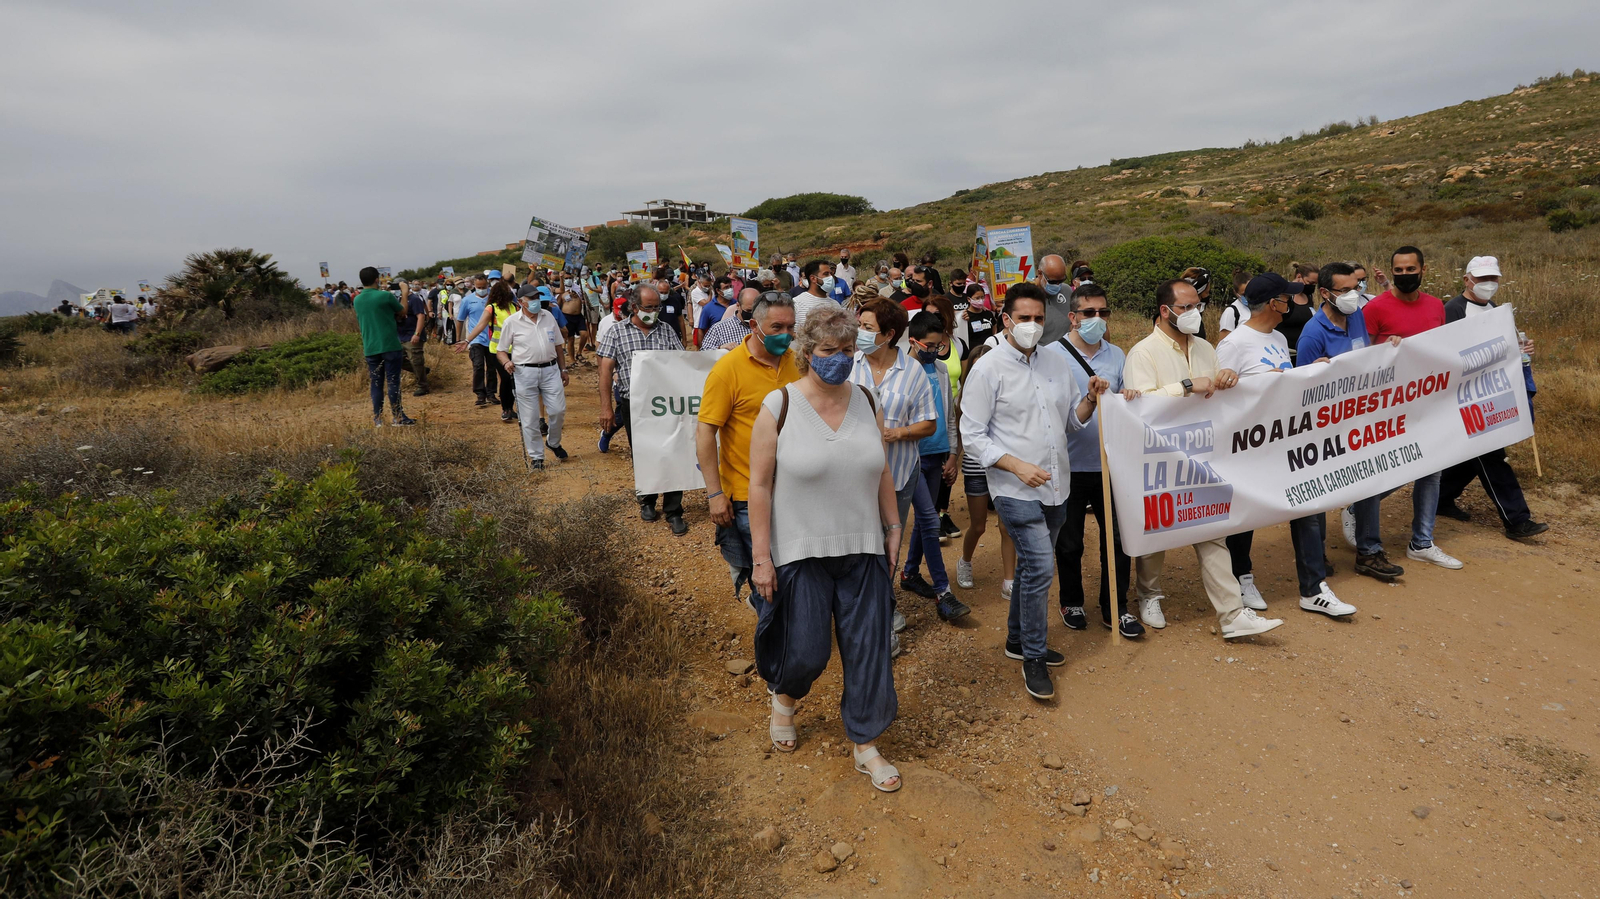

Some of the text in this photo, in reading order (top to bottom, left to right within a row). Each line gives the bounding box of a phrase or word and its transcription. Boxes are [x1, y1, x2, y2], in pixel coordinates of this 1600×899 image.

[996, 283, 1007, 295] NO
[1460, 340, 1508, 372] UNIDAD POR
[1302, 366, 1395, 407] UNIDAD POR LA LÍNEA
[1457, 367, 1512, 405] LA LÍNEA
[1231, 371, 1451, 454] NO A LA SUBESTACIÓN
[1459, 401, 1495, 436] NO A LA
[1485, 406, 1519, 427] SUBESTACION
[1184, 426, 1214, 451] POR
[1287, 414, 1406, 472] NO AL CABLE
[1143, 460, 1167, 492] LA
[1285, 442, 1424, 507] #SIERRA CARBONERA NO SE TOCA
[1143, 491, 1194, 531] NO A LA
[1177, 501, 1231, 523] SUBESTACION
